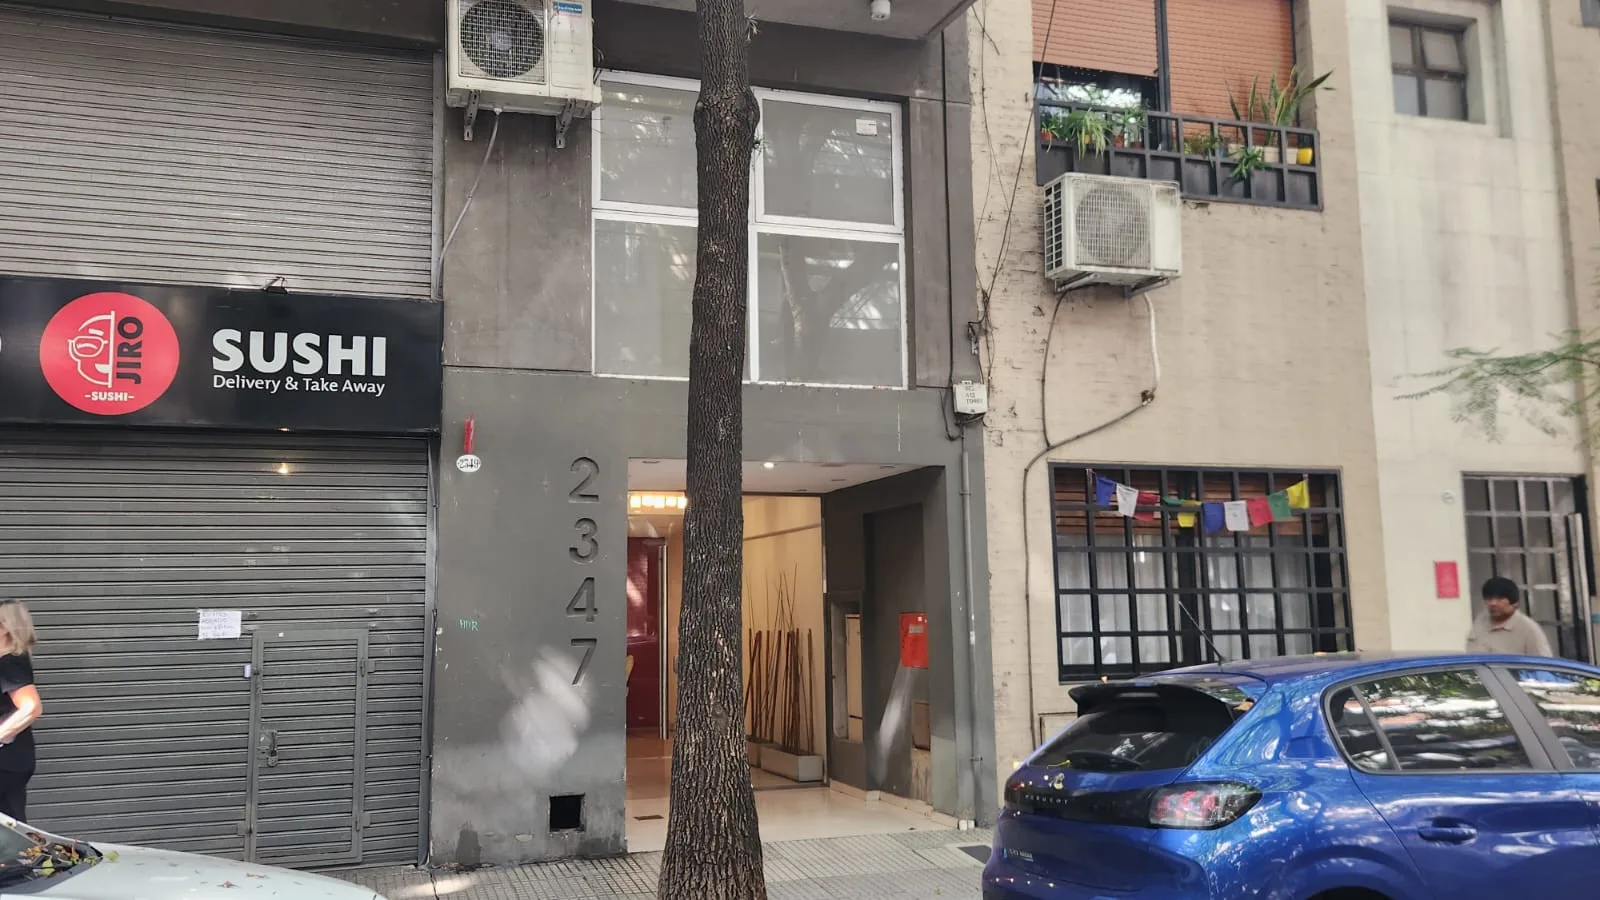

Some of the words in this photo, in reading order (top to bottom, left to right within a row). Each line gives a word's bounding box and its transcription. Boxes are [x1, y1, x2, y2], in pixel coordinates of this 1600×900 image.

[116, 316, 143, 384] JIRO
[212, 328, 387, 377] SUSHI
[213, 374, 281, 394] Delivery
[285, 376, 299, 391] &
[303, 377, 338, 392] Take
[342, 379, 386, 397] Away
[566, 456, 600, 686] 2347
